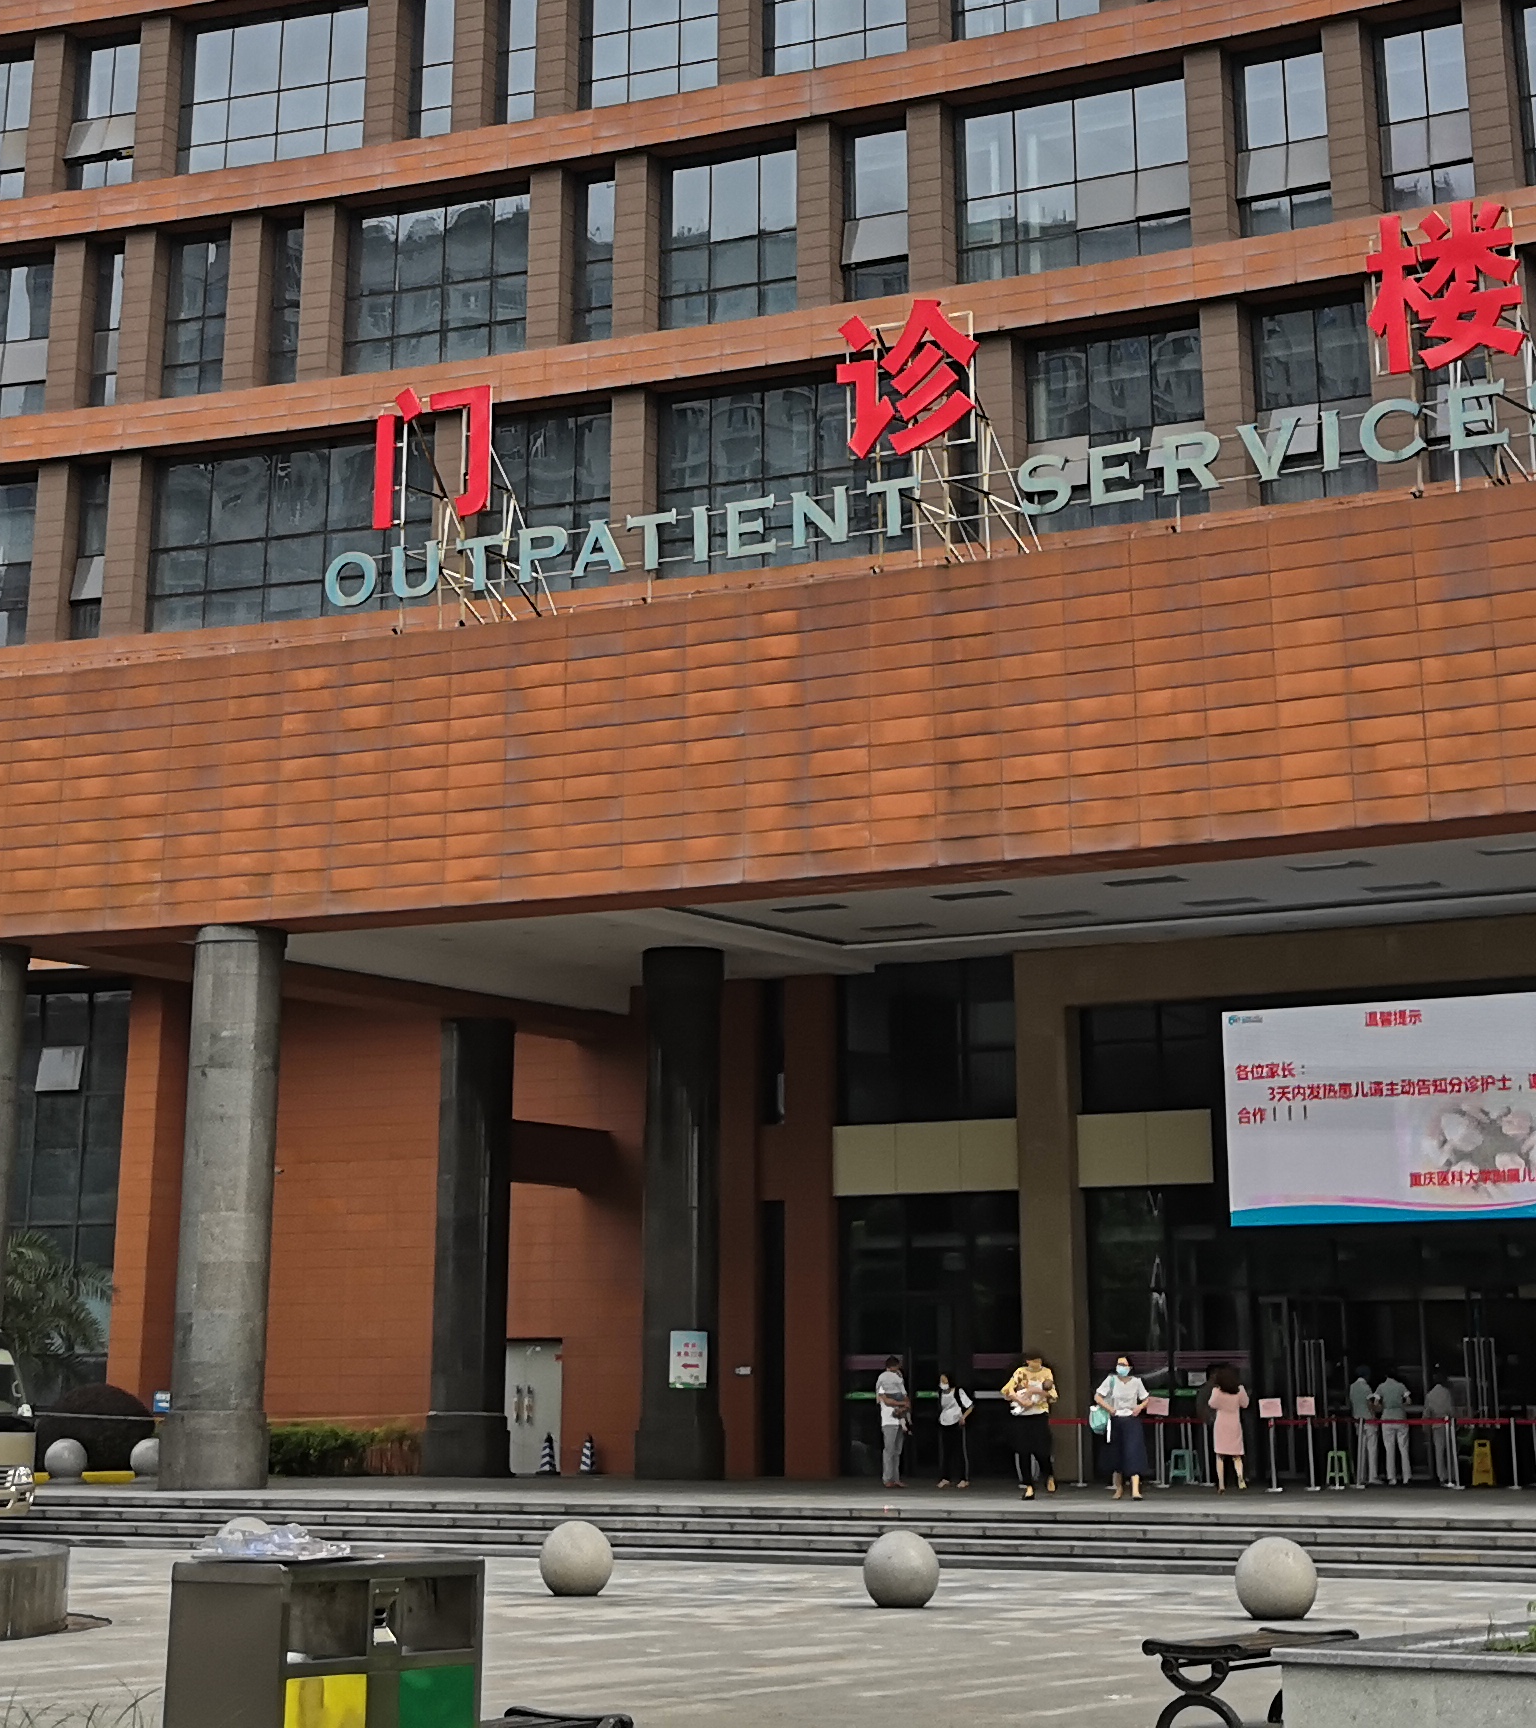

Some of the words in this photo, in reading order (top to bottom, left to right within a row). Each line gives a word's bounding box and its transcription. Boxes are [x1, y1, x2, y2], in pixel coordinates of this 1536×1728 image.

[370, 199, 1526, 531] 门诊楼
[324, 473, 920, 609] OUTPATIENT
